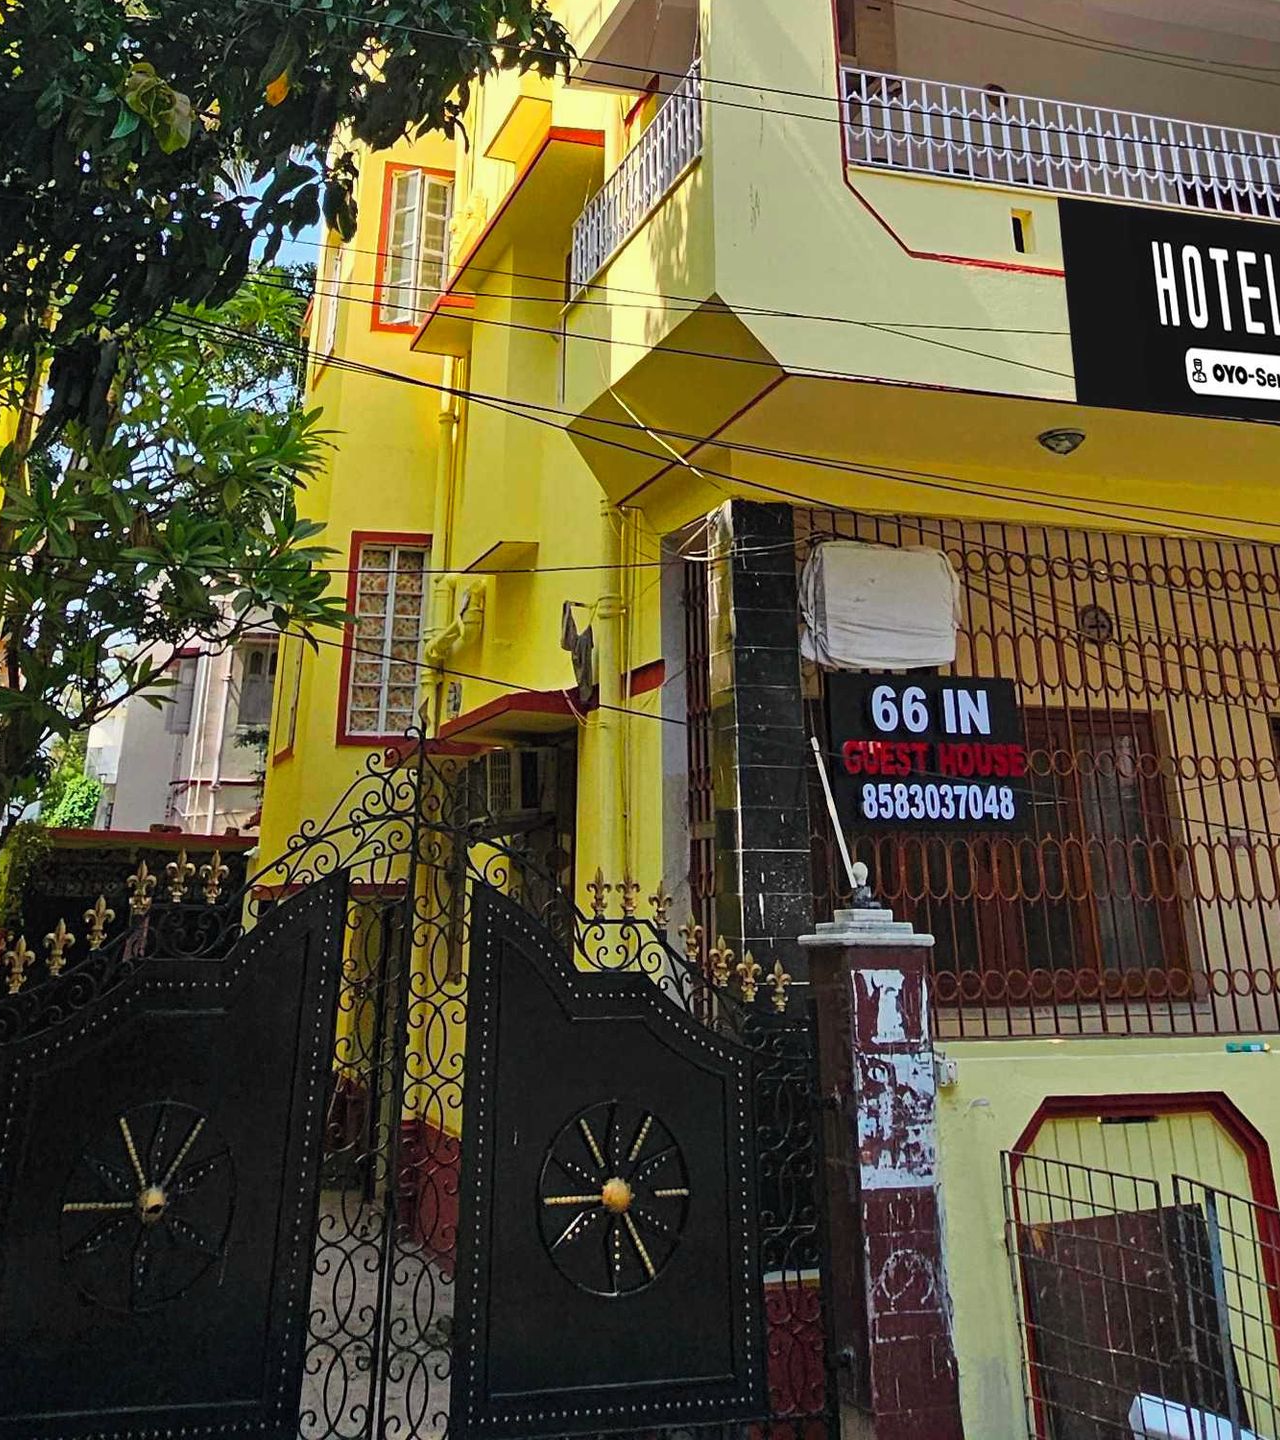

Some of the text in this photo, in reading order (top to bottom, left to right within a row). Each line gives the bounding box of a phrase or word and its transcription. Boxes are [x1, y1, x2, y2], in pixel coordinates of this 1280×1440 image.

[871, 685, 992, 735] 66 IN
[841, 739, 1025, 779] GUEST HOUSE
[862, 783, 1016, 820] 8583037048
